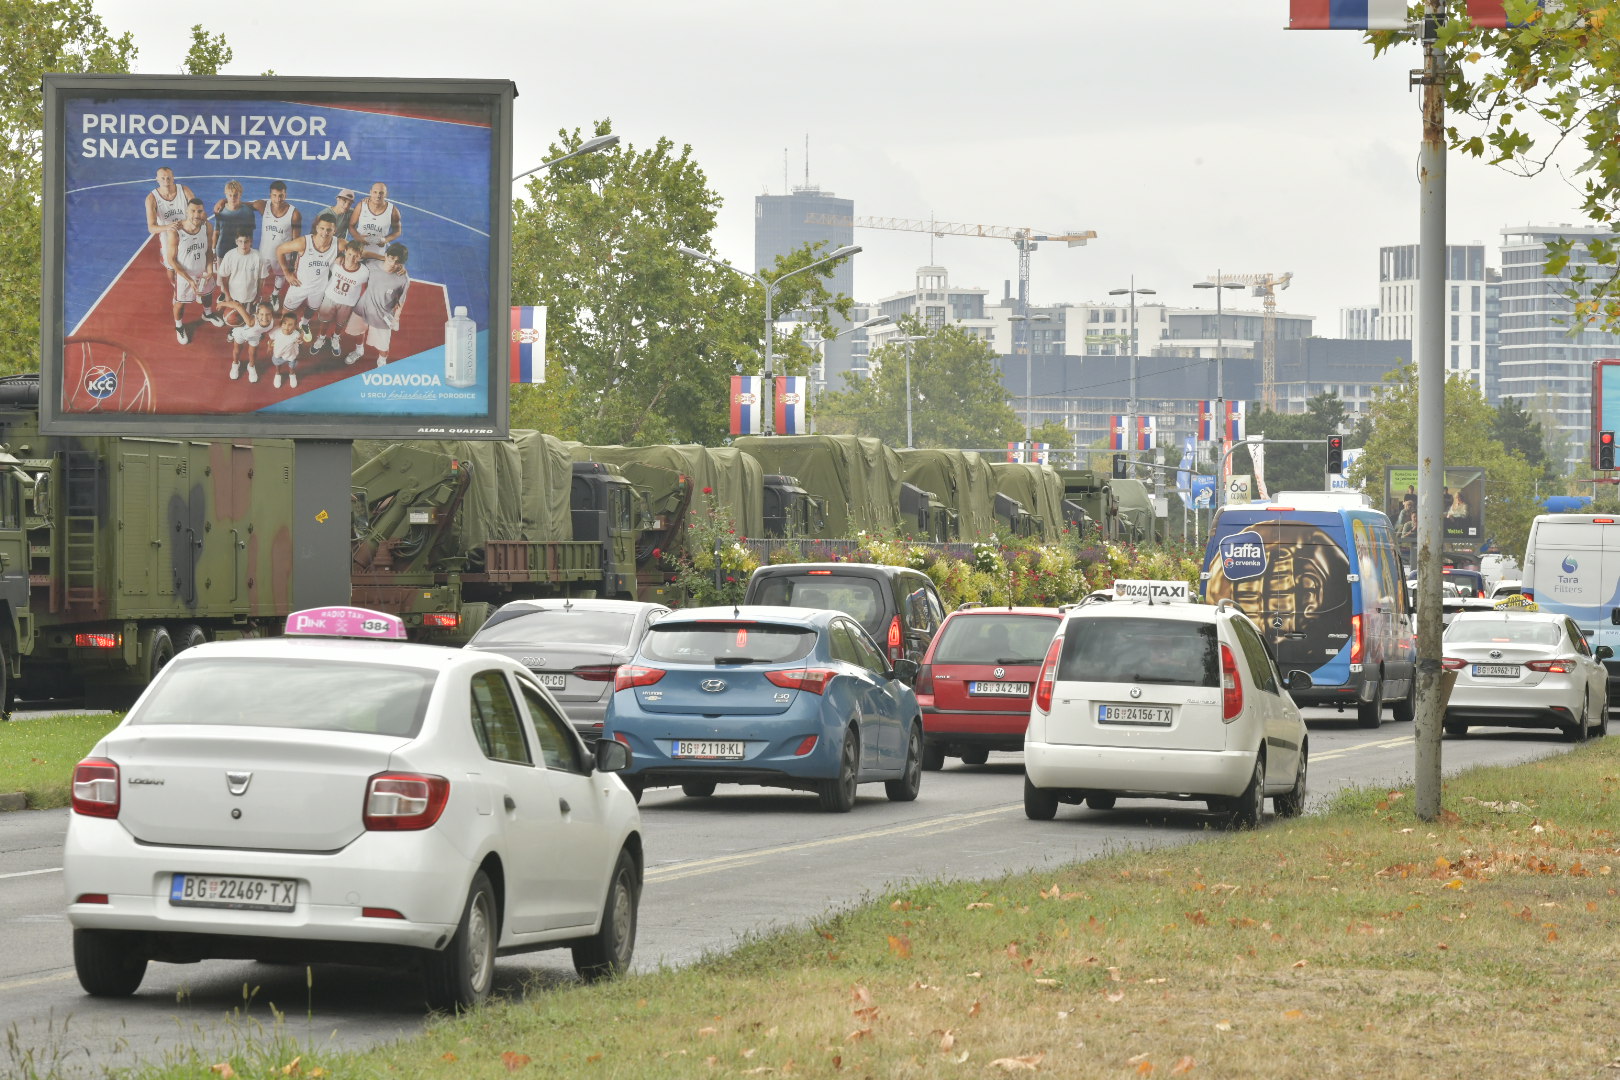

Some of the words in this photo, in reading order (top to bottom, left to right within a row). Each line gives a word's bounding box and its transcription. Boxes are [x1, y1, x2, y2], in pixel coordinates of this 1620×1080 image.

[83, 113, 230, 135] PRIRODAN
[241, 115, 327, 136] IZVOR
[81, 138, 177, 159] SNAGE
[187, 139, 193, 159] I
[204, 139, 351, 161] ZDRAVLJA
[335, 279, 350, 293] 10
[88, 380, 114, 391] KCC
[361, 373, 442, 387] VODAVODA
[1224, 543, 1261, 558] Jaffa
[1557, 575, 1579, 584] Tara
[1126, 585, 1148, 597] 0242
[1150, 585, 1185, 598] TAXI
[1554, 585, 1583, 593] Filters
[362, 621, 390, 632] 1384
[1477, 666, 1487, 674] BG
[976, 682, 988, 692] BG
[1106, 707, 1120, 720] BG
[680, 742, 693, 755] BG
[128, 777, 165, 786] LOGAN
[184, 876, 207, 899] BG
